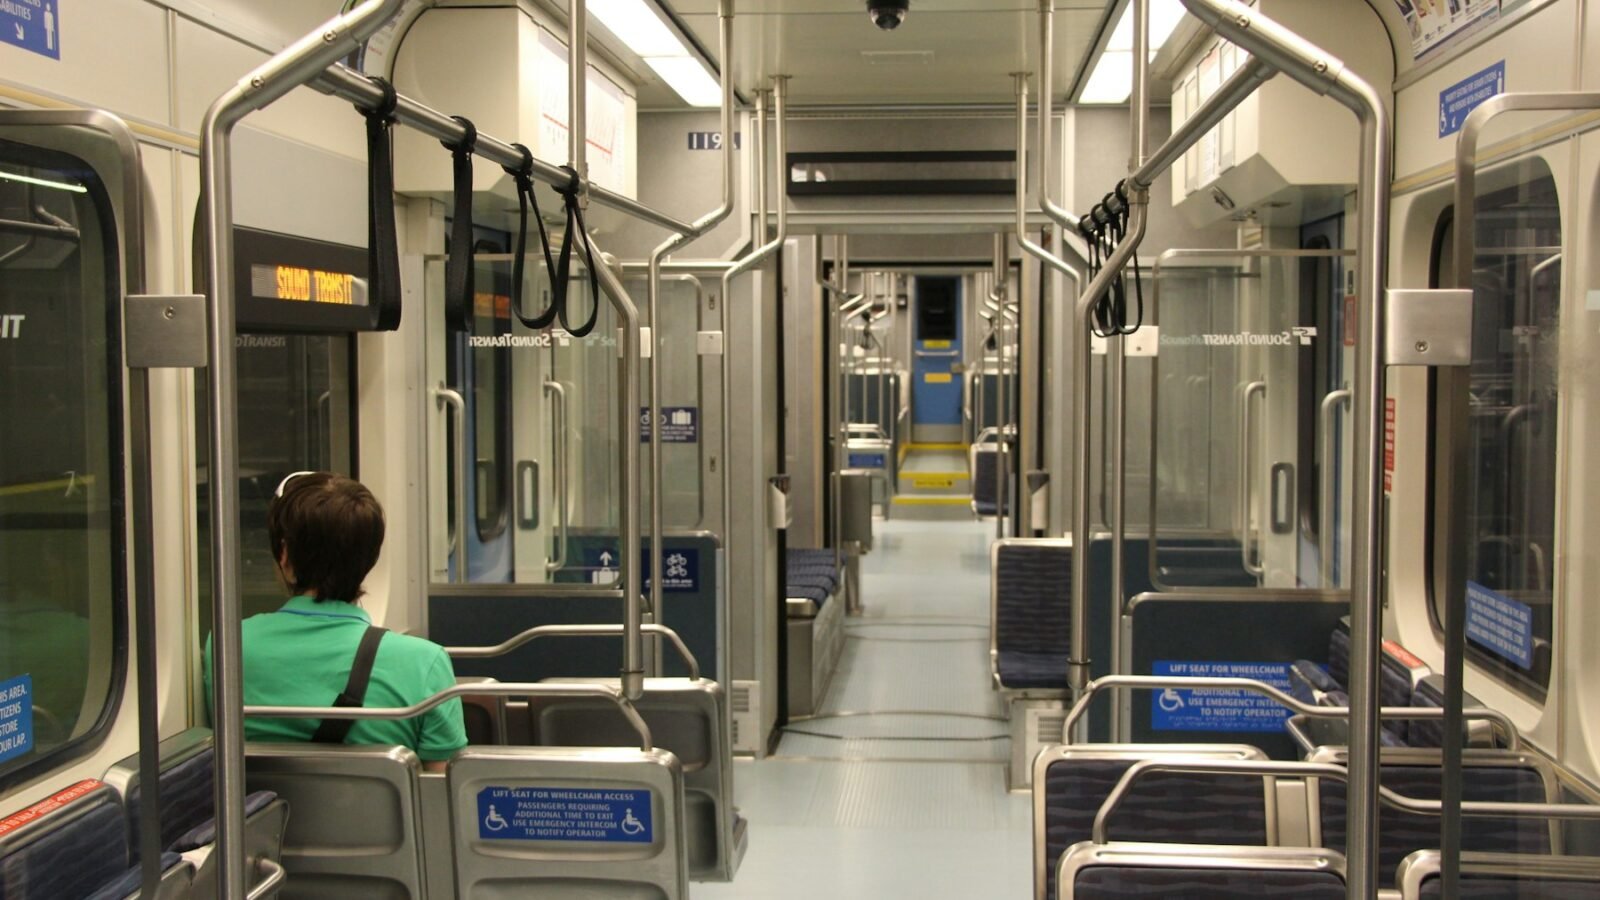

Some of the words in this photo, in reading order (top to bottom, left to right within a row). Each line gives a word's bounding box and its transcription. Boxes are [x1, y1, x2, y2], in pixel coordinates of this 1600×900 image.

[276, 265, 310, 300] SOUND
[313, 270, 352, 305] TRANSIT
[1169, 664, 1187, 673] LIFT
[1189, 664, 1210, 673] SEAT
[1212, 664, 1228, 673] FOR
[1230, 664, 1285, 674] WHEELCHAIR
[9, 684, 27, 700] AREA.
[1192, 688, 1242, 697] ADDITIONAL
[1188, 697, 1204, 706] USE
[1206, 698, 1254, 707] EMERGENCY
[1200, 708, 1212, 716] TO
[1213, 708, 1242, 716] NOTIFY
[1243, 708, 1287, 717] OPERATOR
[13, 732, 26, 748] LAP.
[492, 790, 508, 798] LIFT
[511, 790, 530, 798] SEAT
[550, 791, 602, 800] WHEELCHAIR
[604, 792, 634, 801] ACCESS
[517, 801, 566, 810] PASSENGERS
[568, 803, 610, 811] REQUIRING
[515, 810, 561, 818] ADDITIONAL
[564, 811, 582, 819] TIME
[597, 812, 613, 820] EXIT
[512, 819, 527, 827] USE
[529, 819, 575, 828] EMERGENCY
[577, 821, 617, 829] INTERCOM
[524, 828, 536, 836] TO
[537, 828, 564, 836] NOTIFY
[566, 829, 607, 837] OPERATOR
